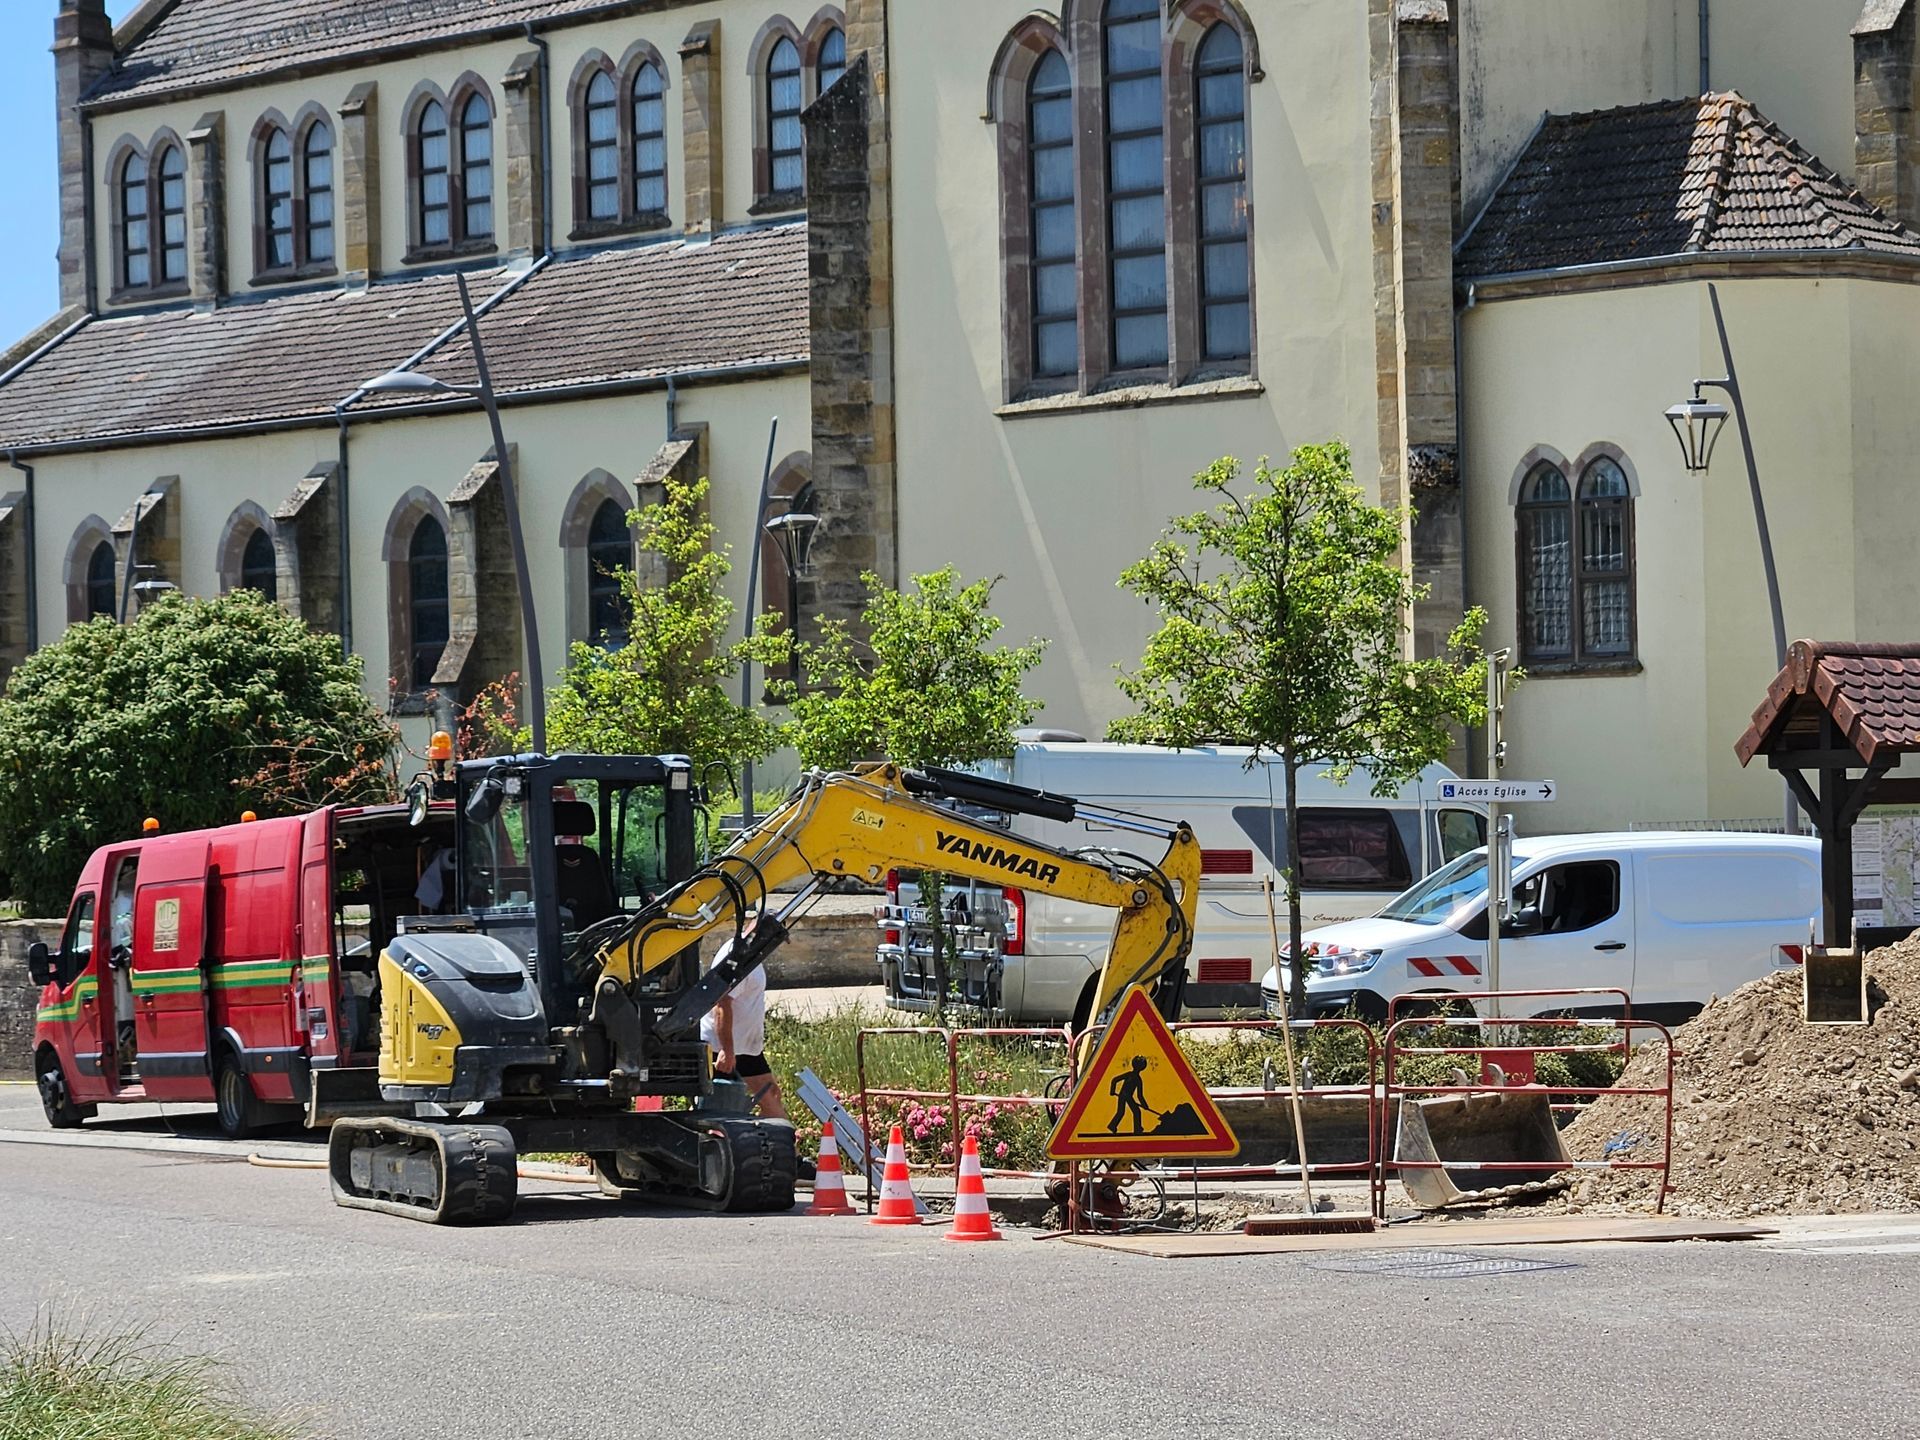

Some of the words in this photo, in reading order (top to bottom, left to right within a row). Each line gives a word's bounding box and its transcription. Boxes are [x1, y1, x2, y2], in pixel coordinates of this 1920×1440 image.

[1457, 786, 1488, 797] Accès
[1494, 786, 1527, 798] Eglise
[936, 830, 1061, 884] YANMAR
